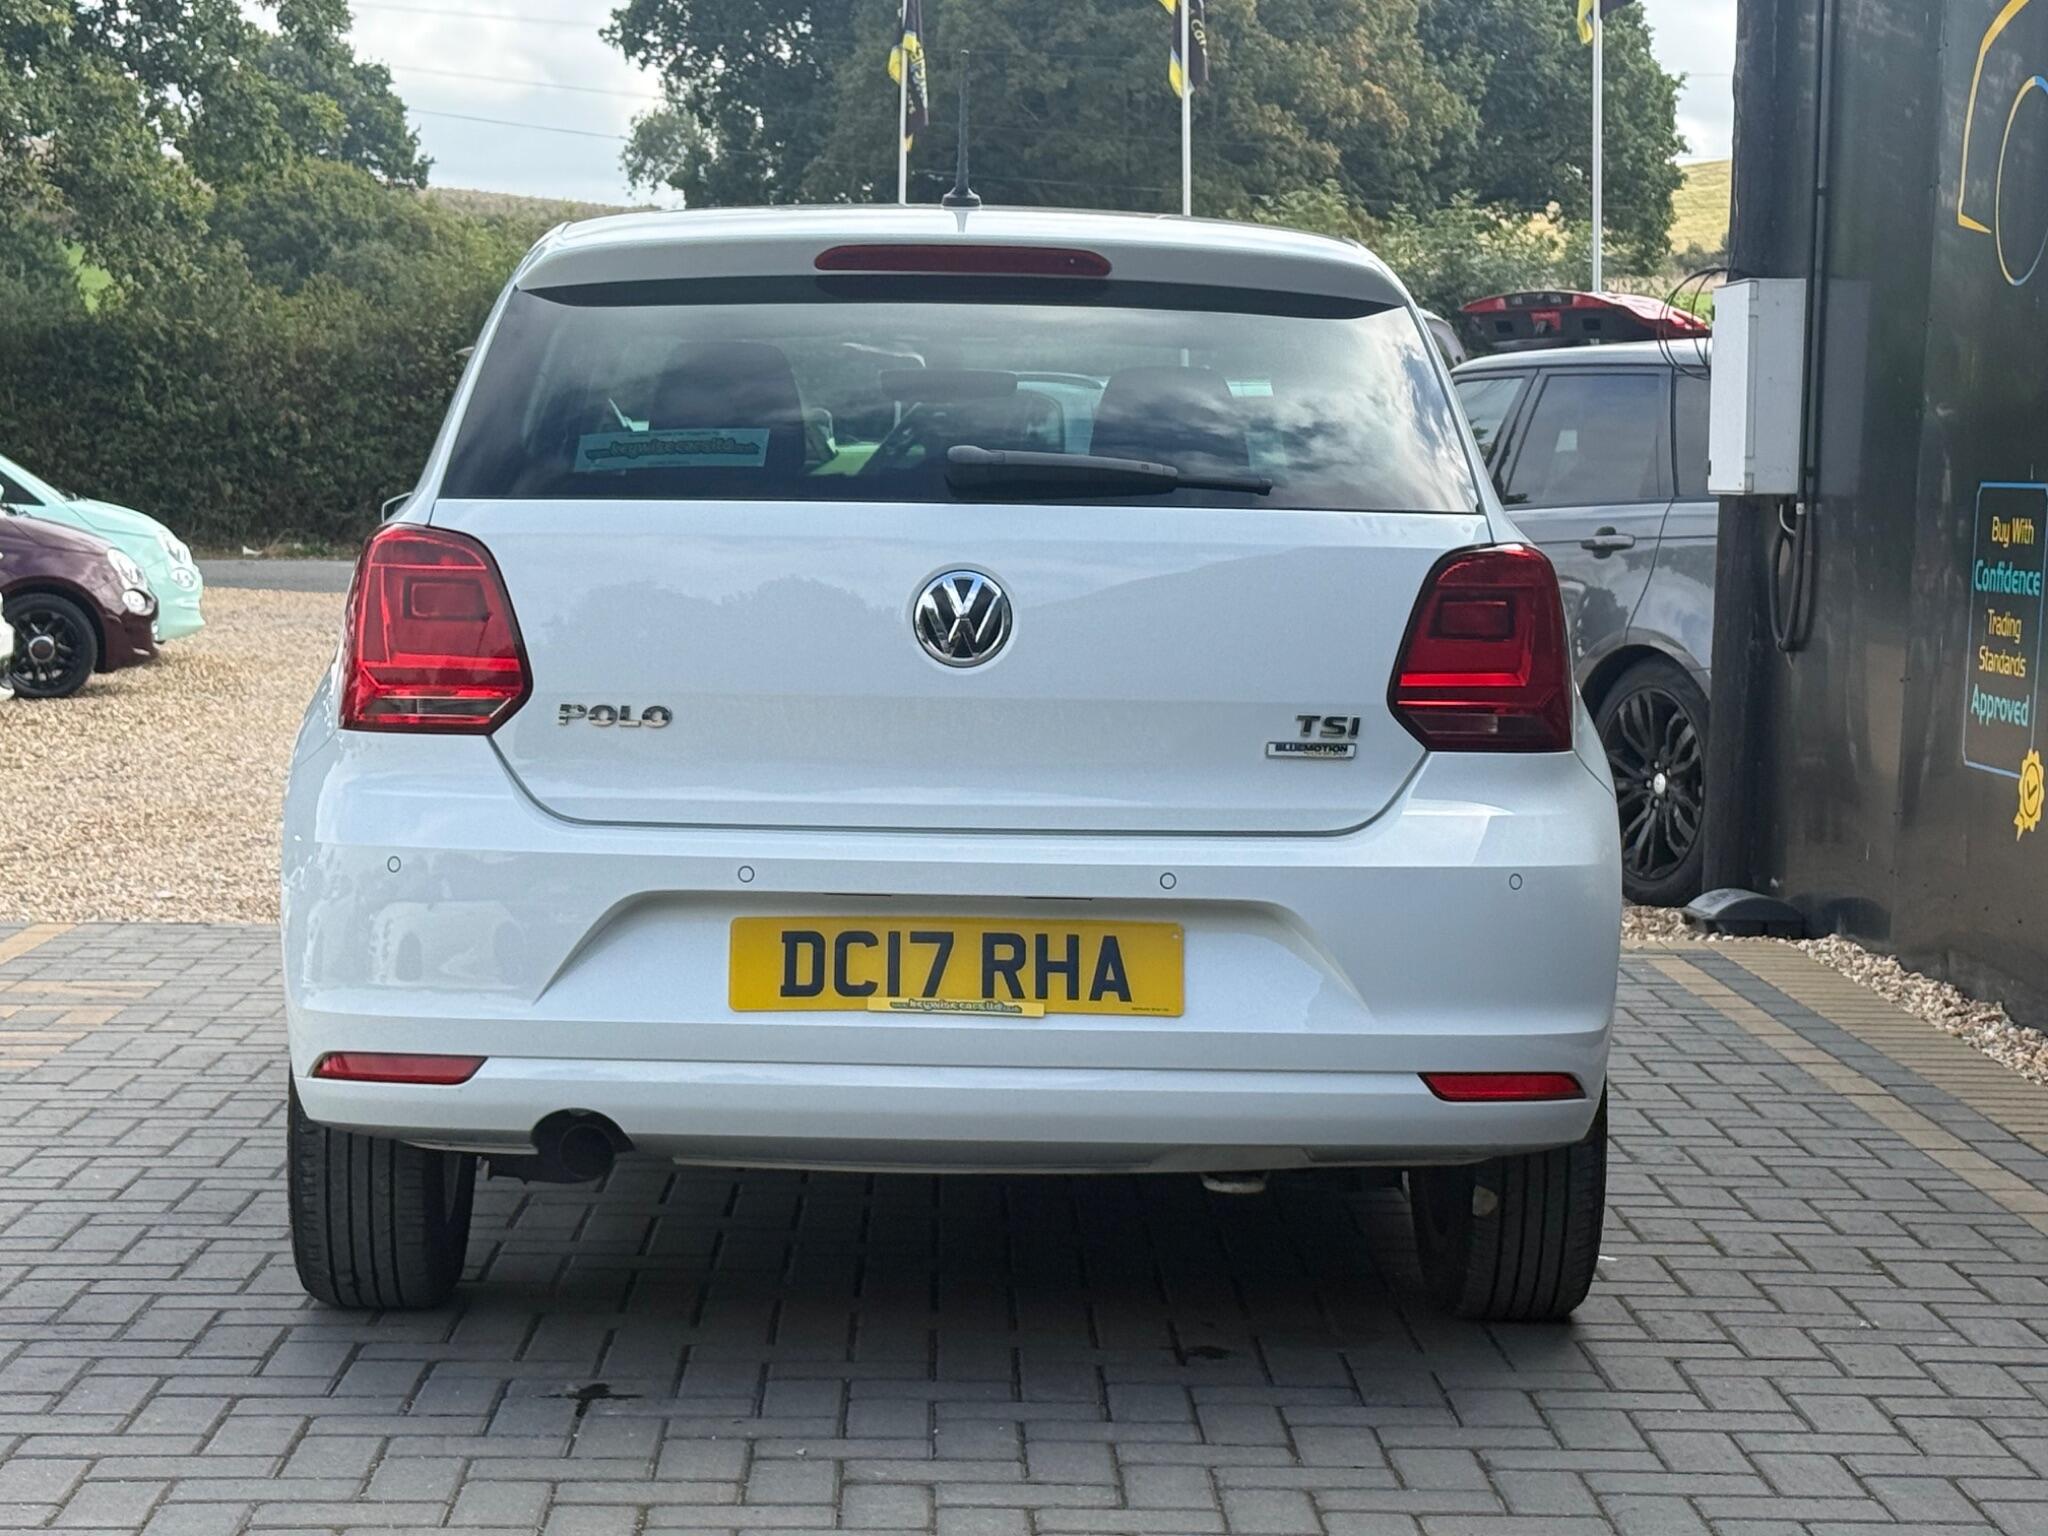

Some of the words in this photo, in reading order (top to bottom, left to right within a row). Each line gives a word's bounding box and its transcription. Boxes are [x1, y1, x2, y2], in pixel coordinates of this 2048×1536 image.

[1991, 515, 2011, 548] Buy
[2012, 517, 2034, 545] With
[1975, 559, 2041, 596] Confidence
[1987, 608, 2022, 644] Trading
[1979, 645, 2026, 678] Standards
[558, 703, 673, 729] POLO
[1970, 683, 2030, 727] Approved
[1296, 714, 1361, 739] TSI
[780, 930, 954, 999] DC17
[981, 932, 1133, 1003] RHA
